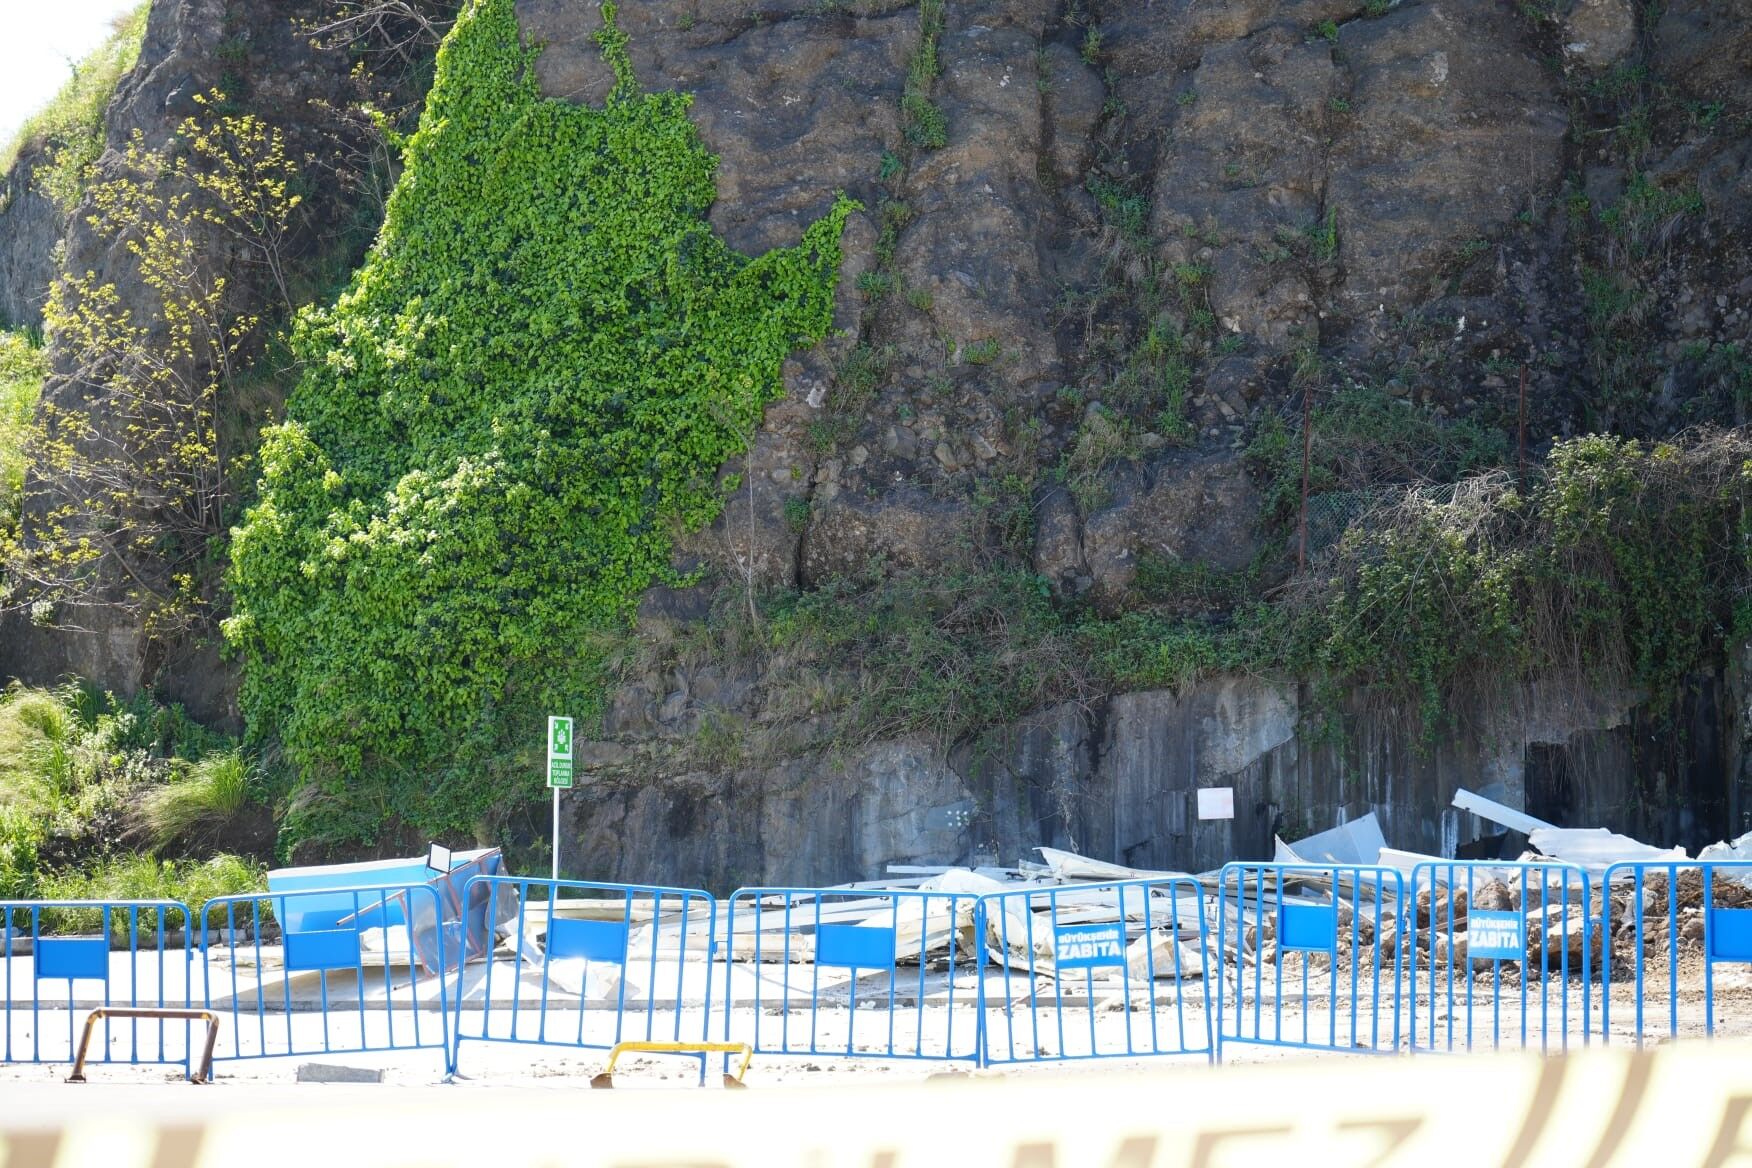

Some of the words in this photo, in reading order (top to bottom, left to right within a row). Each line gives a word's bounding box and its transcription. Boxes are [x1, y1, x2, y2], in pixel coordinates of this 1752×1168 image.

[1057, 928, 1119, 945] BÜYÜKŞEHİR
[1470, 930, 1520, 948] ZABITA
[1057, 940, 1122, 960] ZABITA
